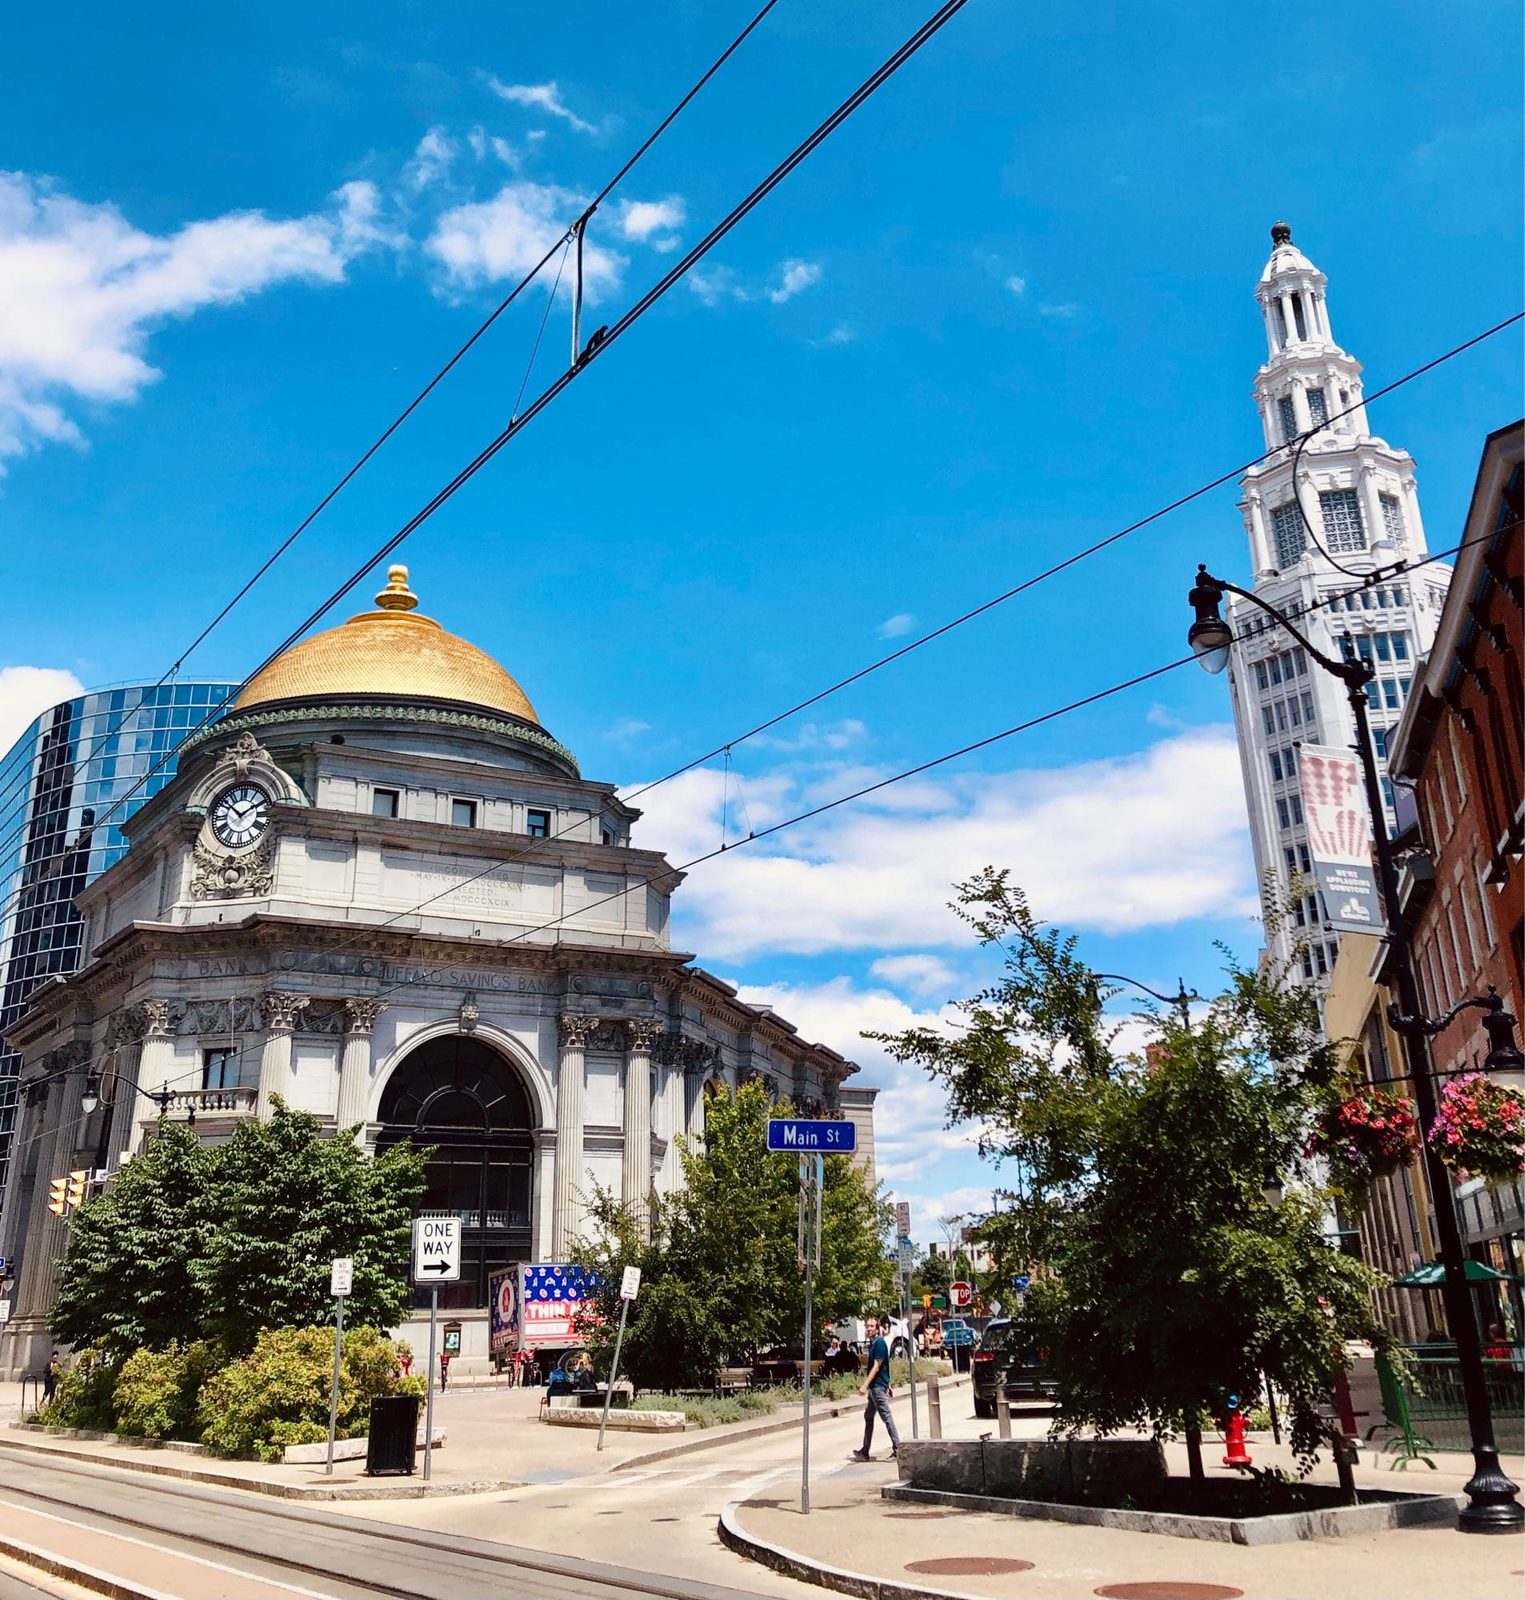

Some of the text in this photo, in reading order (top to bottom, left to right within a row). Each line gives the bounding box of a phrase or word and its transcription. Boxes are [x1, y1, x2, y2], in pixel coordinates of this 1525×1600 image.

[450, 970, 510, 990] SAVINGS
[518, 976, 557, 993] BANK
[784, 1125, 840, 1146] Main St
[424, 1223, 453, 1237] ONE
[423, 1241, 453, 1255] WAY
[528, 1303, 565, 1318] THIN
